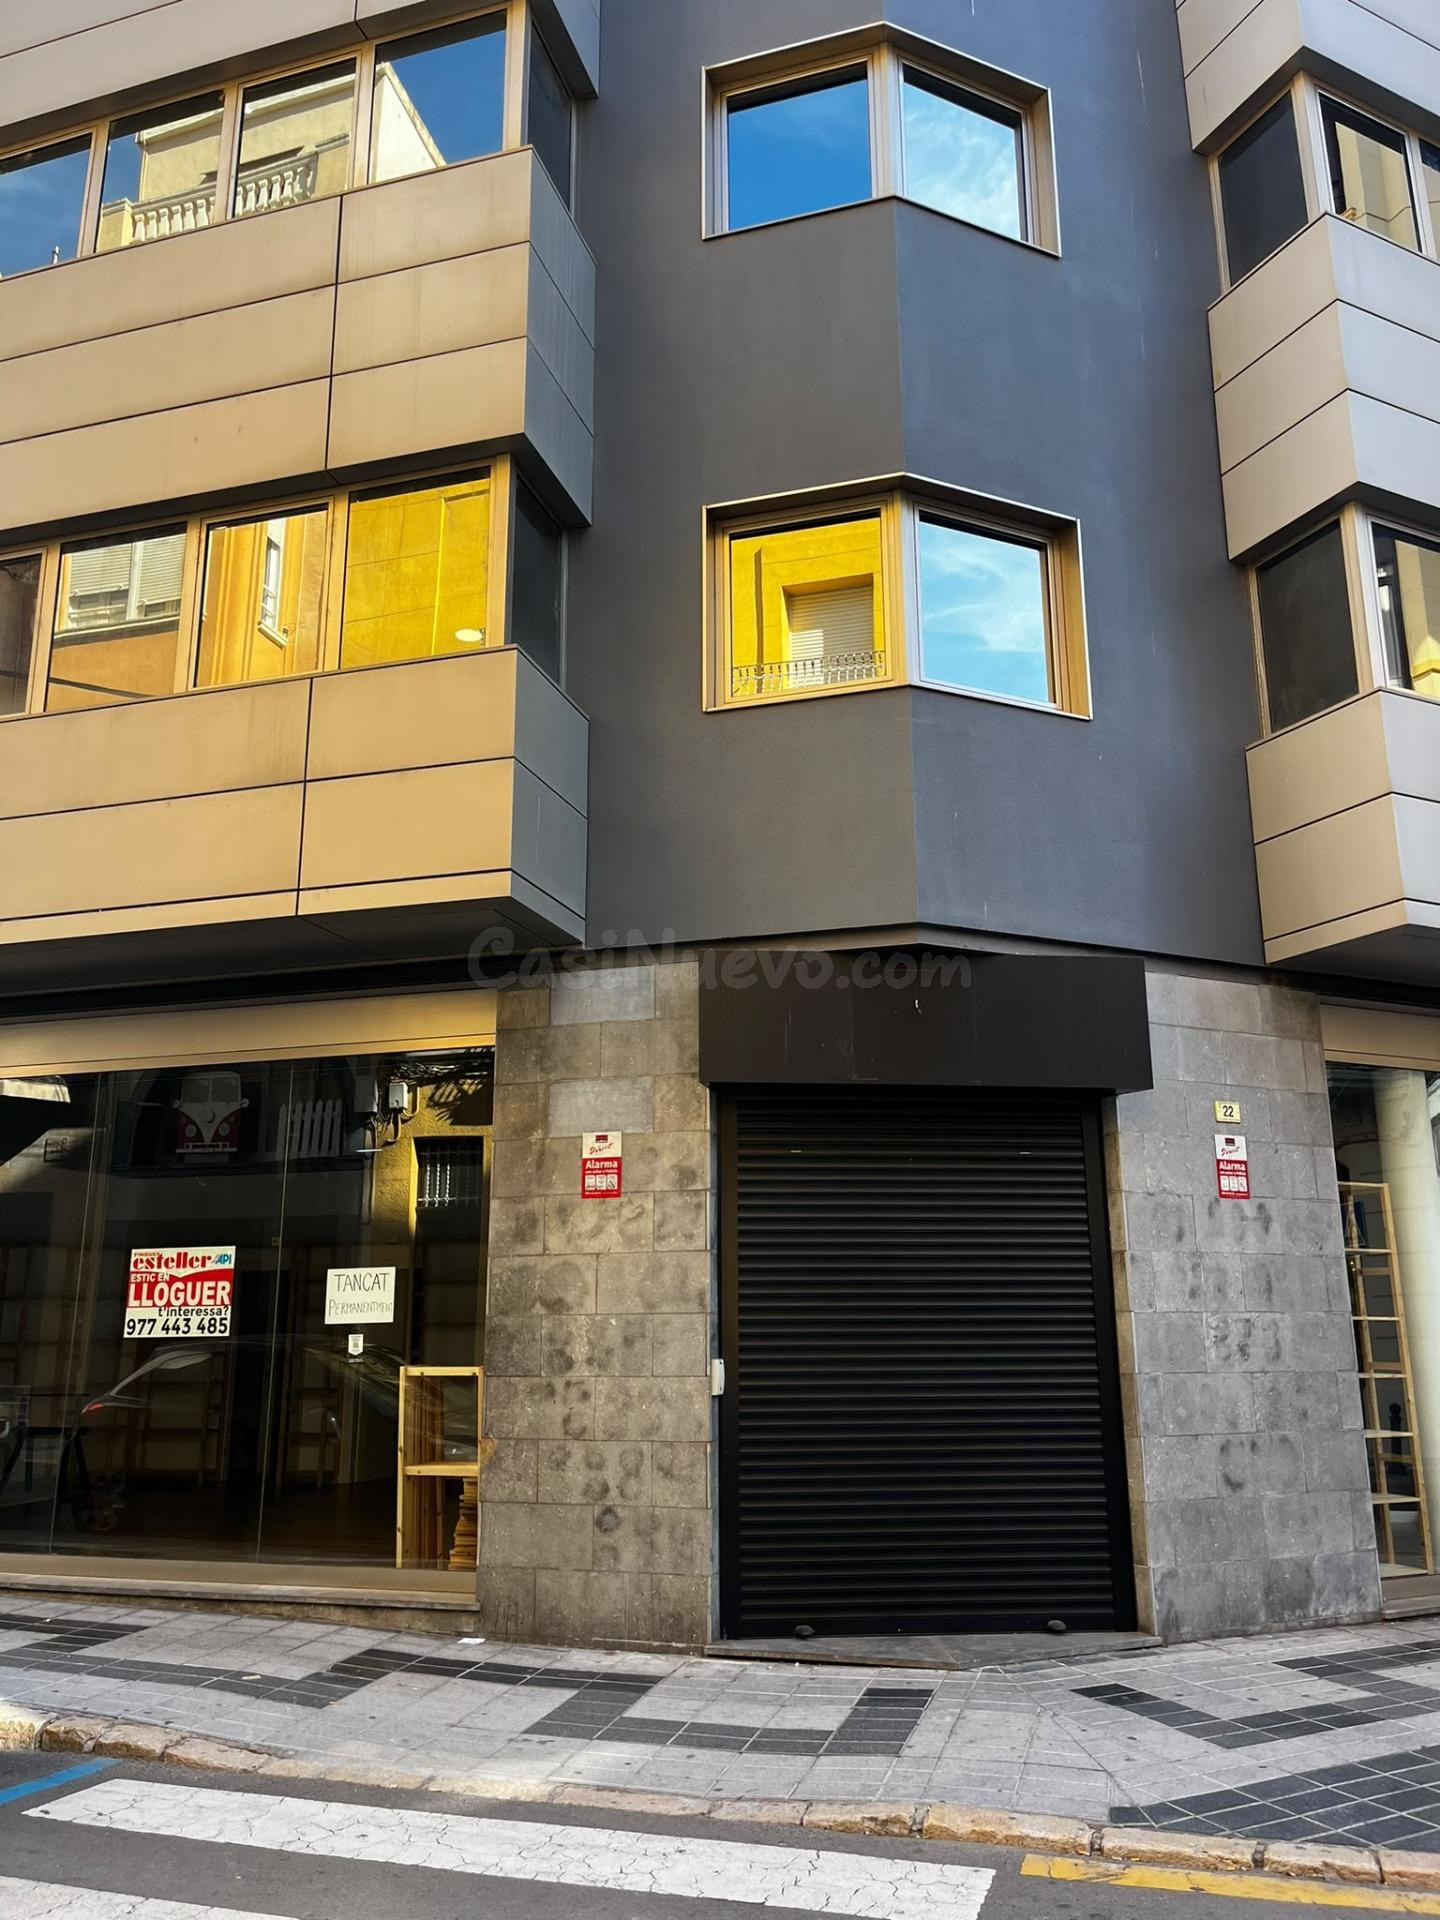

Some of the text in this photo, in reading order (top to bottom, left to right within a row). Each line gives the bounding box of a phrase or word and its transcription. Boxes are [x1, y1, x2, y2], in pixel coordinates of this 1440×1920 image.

[1222, 1105, 1234, 1118] 22
[585, 1160, 618, 1170] Alarma
[1219, 1161, 1246, 1171] Alarma
[133, 1251, 212, 1270] esteller
[215, 1254, 232, 1265] API
[130, 1272, 170, 1282] ESTIC EN
[334, 1272, 390, 1292] TANCAT
[128, 1280, 231, 1307] LLOGUER
[158, 1305, 229, 1317] t'interessa?
[126, 1316, 228, 1336] 977 443 485
